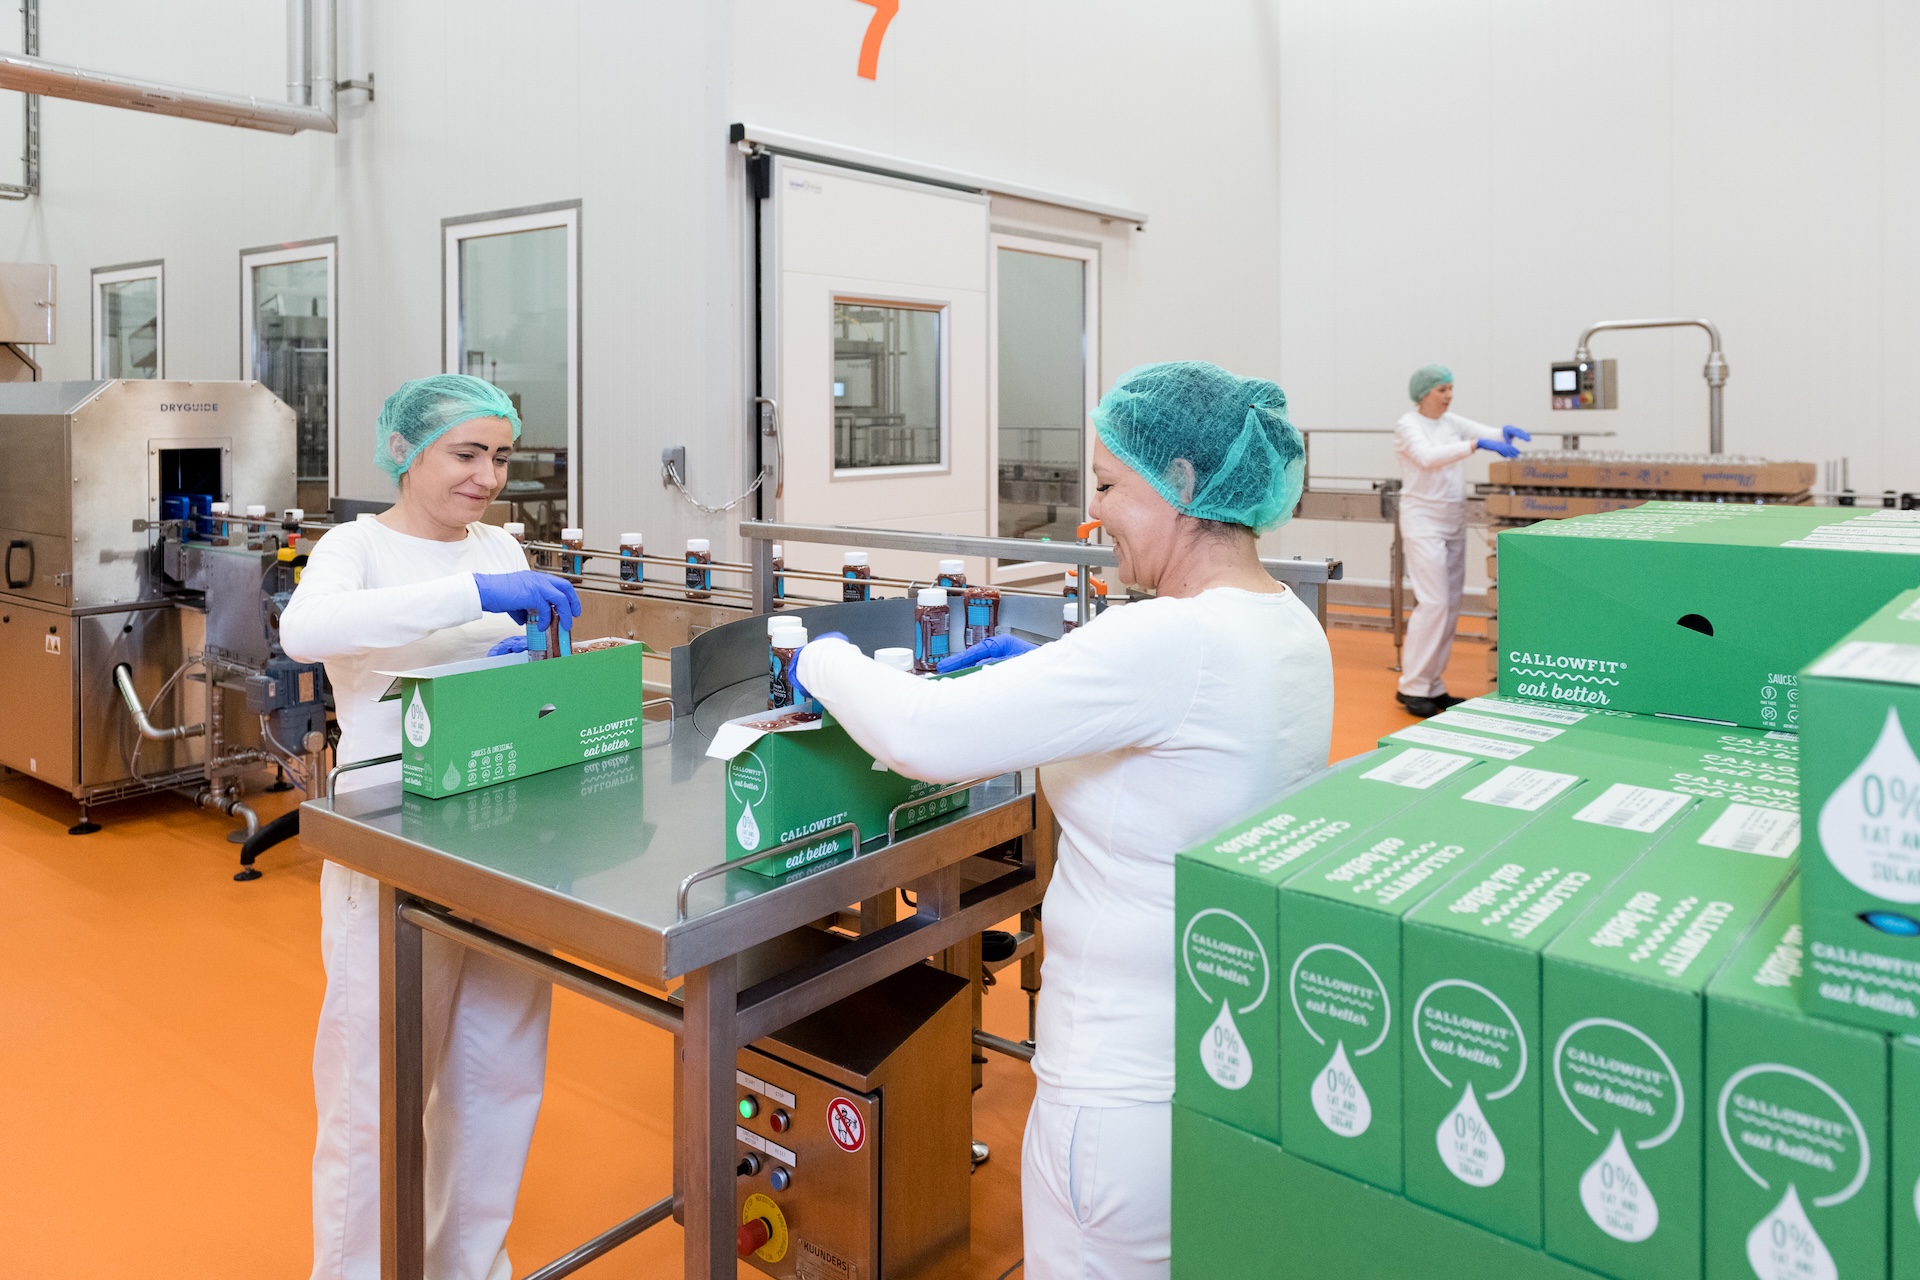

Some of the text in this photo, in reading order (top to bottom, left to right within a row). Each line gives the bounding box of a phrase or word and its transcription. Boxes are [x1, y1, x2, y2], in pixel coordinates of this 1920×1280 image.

[854, 0, 899, 81] 7
[160, 403, 219, 412] DRYGUIDE
[1517, 681, 1611, 706] eat better
[1767, 672, 1798, 686] SAUCES
[584, 738, 631, 757] eat better
[786, 840, 839, 869] eat better
[1213, 1025, 1240, 1054] 0%
[1326, 1068, 1356, 1099] 0%
[1454, 1112, 1488, 1147] 0%
[1600, 1161, 1639, 1198] 0%
[1771, 1218, 1816, 1258] 0%
[803, 1241, 847, 1271] KUUNDERS
